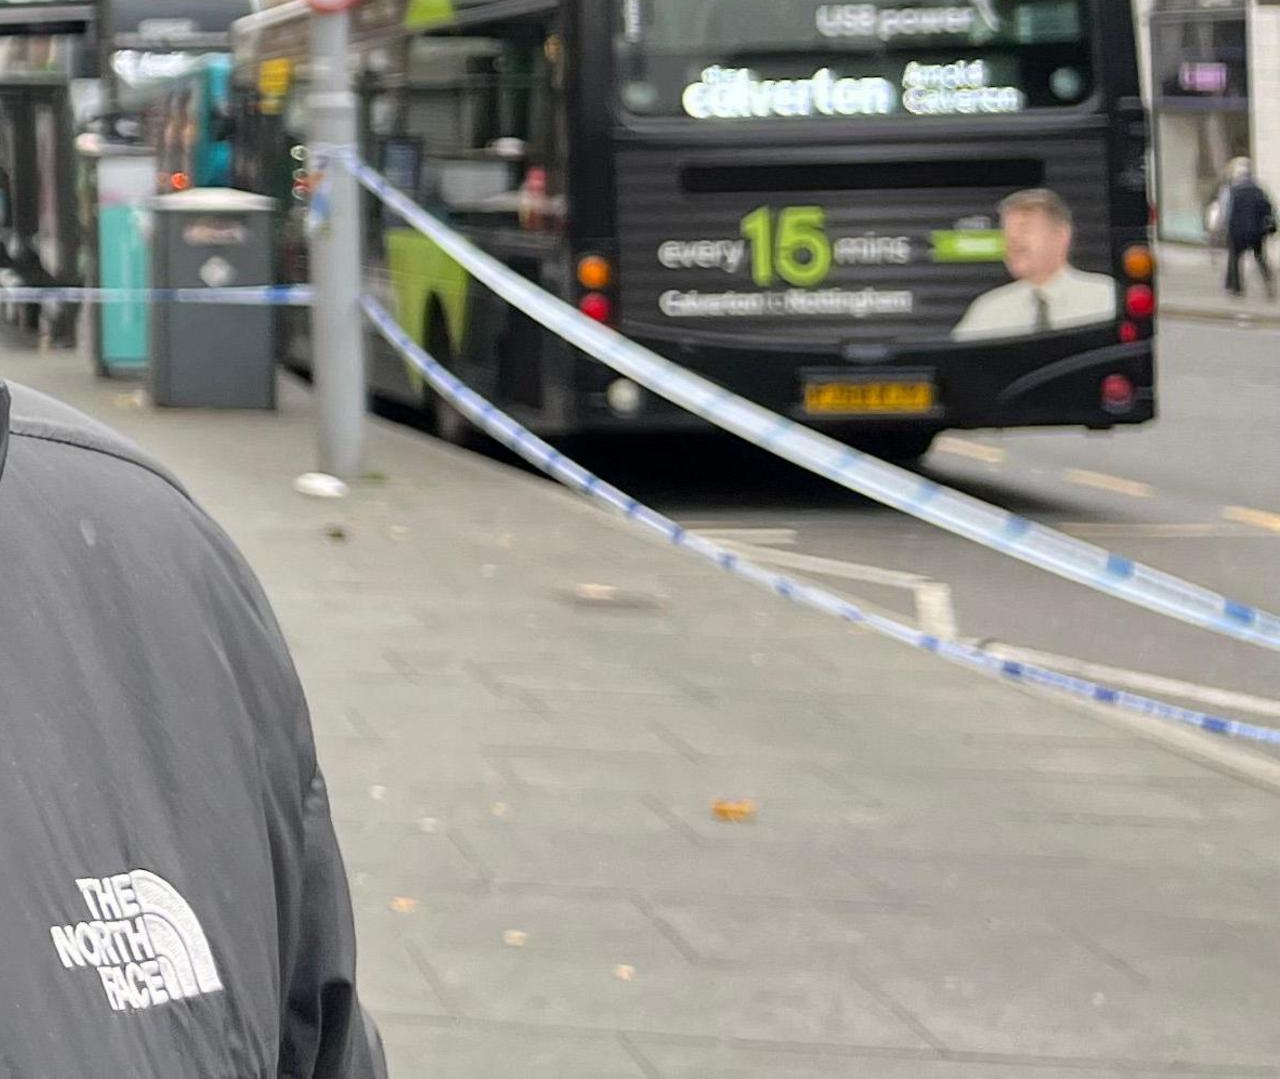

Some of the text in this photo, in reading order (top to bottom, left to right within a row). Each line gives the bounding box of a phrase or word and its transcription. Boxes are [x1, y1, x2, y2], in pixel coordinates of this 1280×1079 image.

[815, 3, 877, 37] USB
[878, 7, 975, 41] power
[657, 204, 911, 288] every 15 mins
[74, 872, 141, 919] THE
[49, 914, 156, 969] NORTH
[96, 960, 170, 1012] FACE
